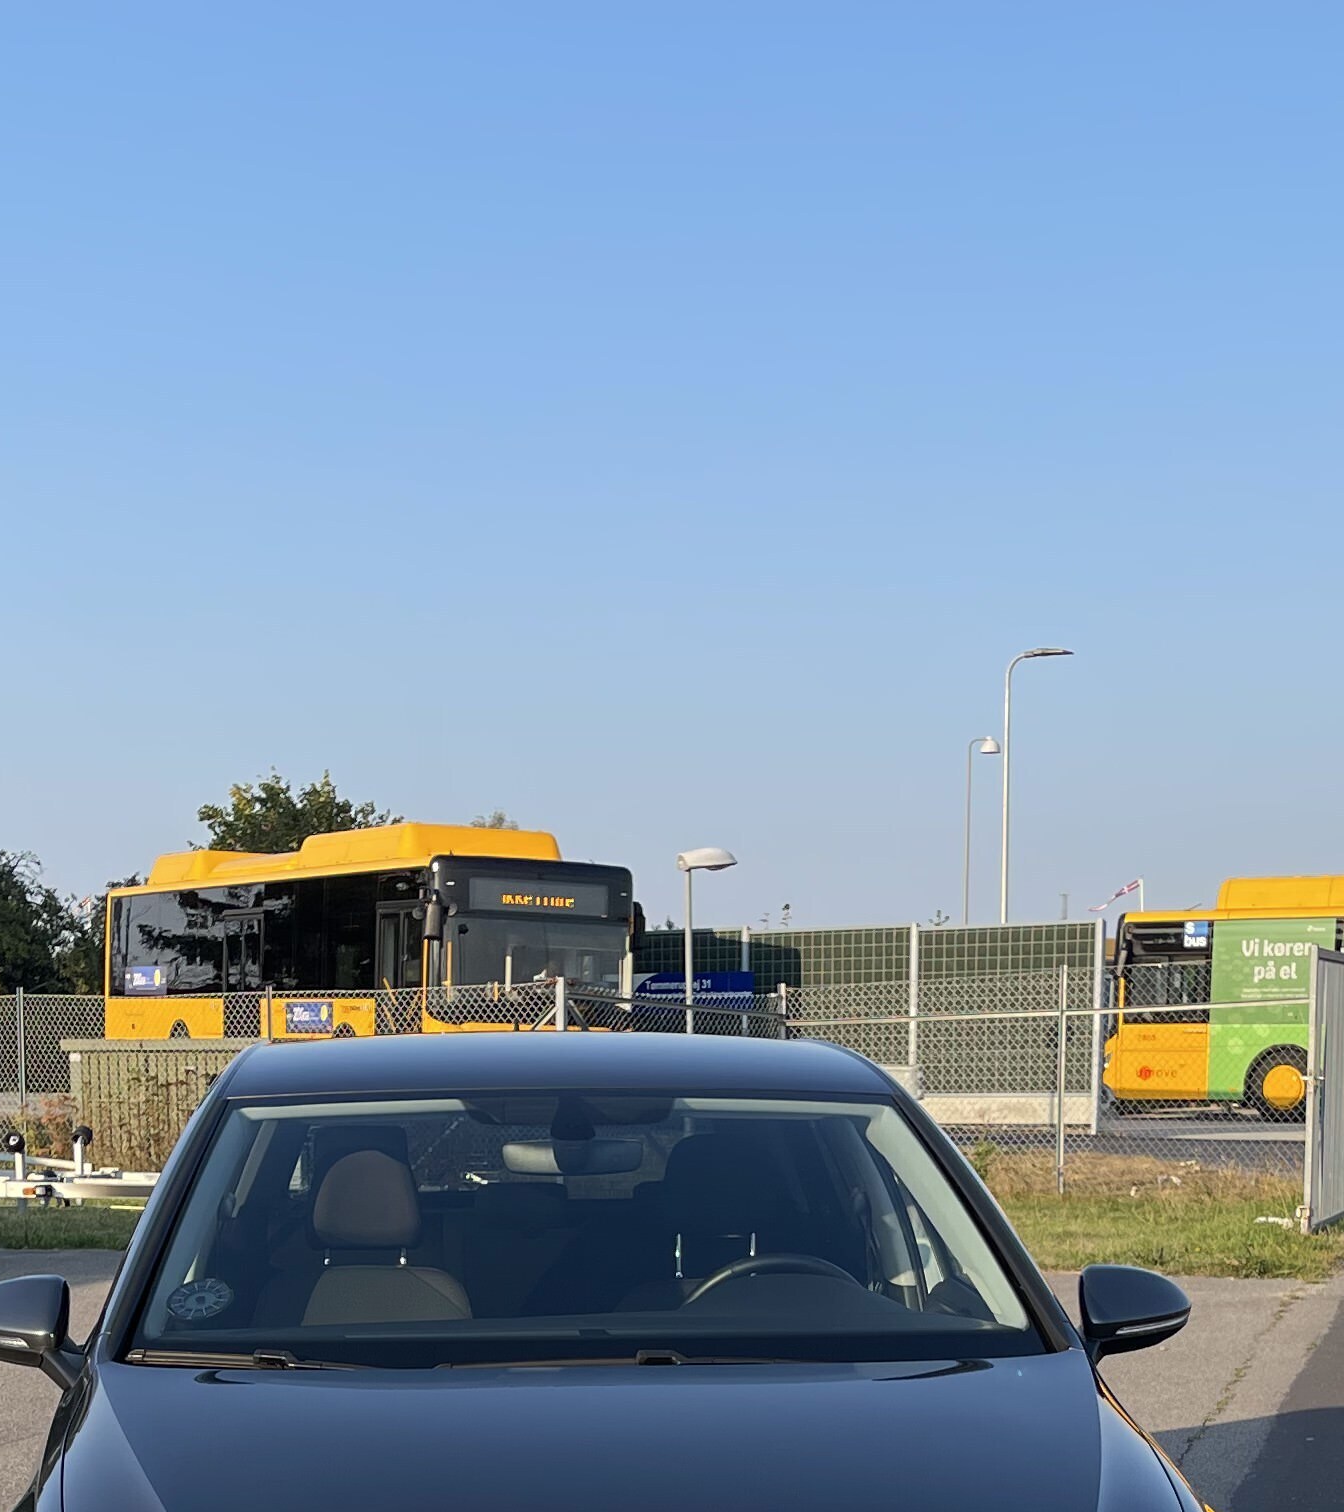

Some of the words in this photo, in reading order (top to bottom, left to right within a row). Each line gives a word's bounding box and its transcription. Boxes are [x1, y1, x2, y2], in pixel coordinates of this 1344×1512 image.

[1184, 935, 1207, 948] bus
[1241, 937, 1259, 958] Vi
[1253, 961, 1276, 982] på
[1279, 962, 1298, 980] el
[701, 980, 711, 989] 31
